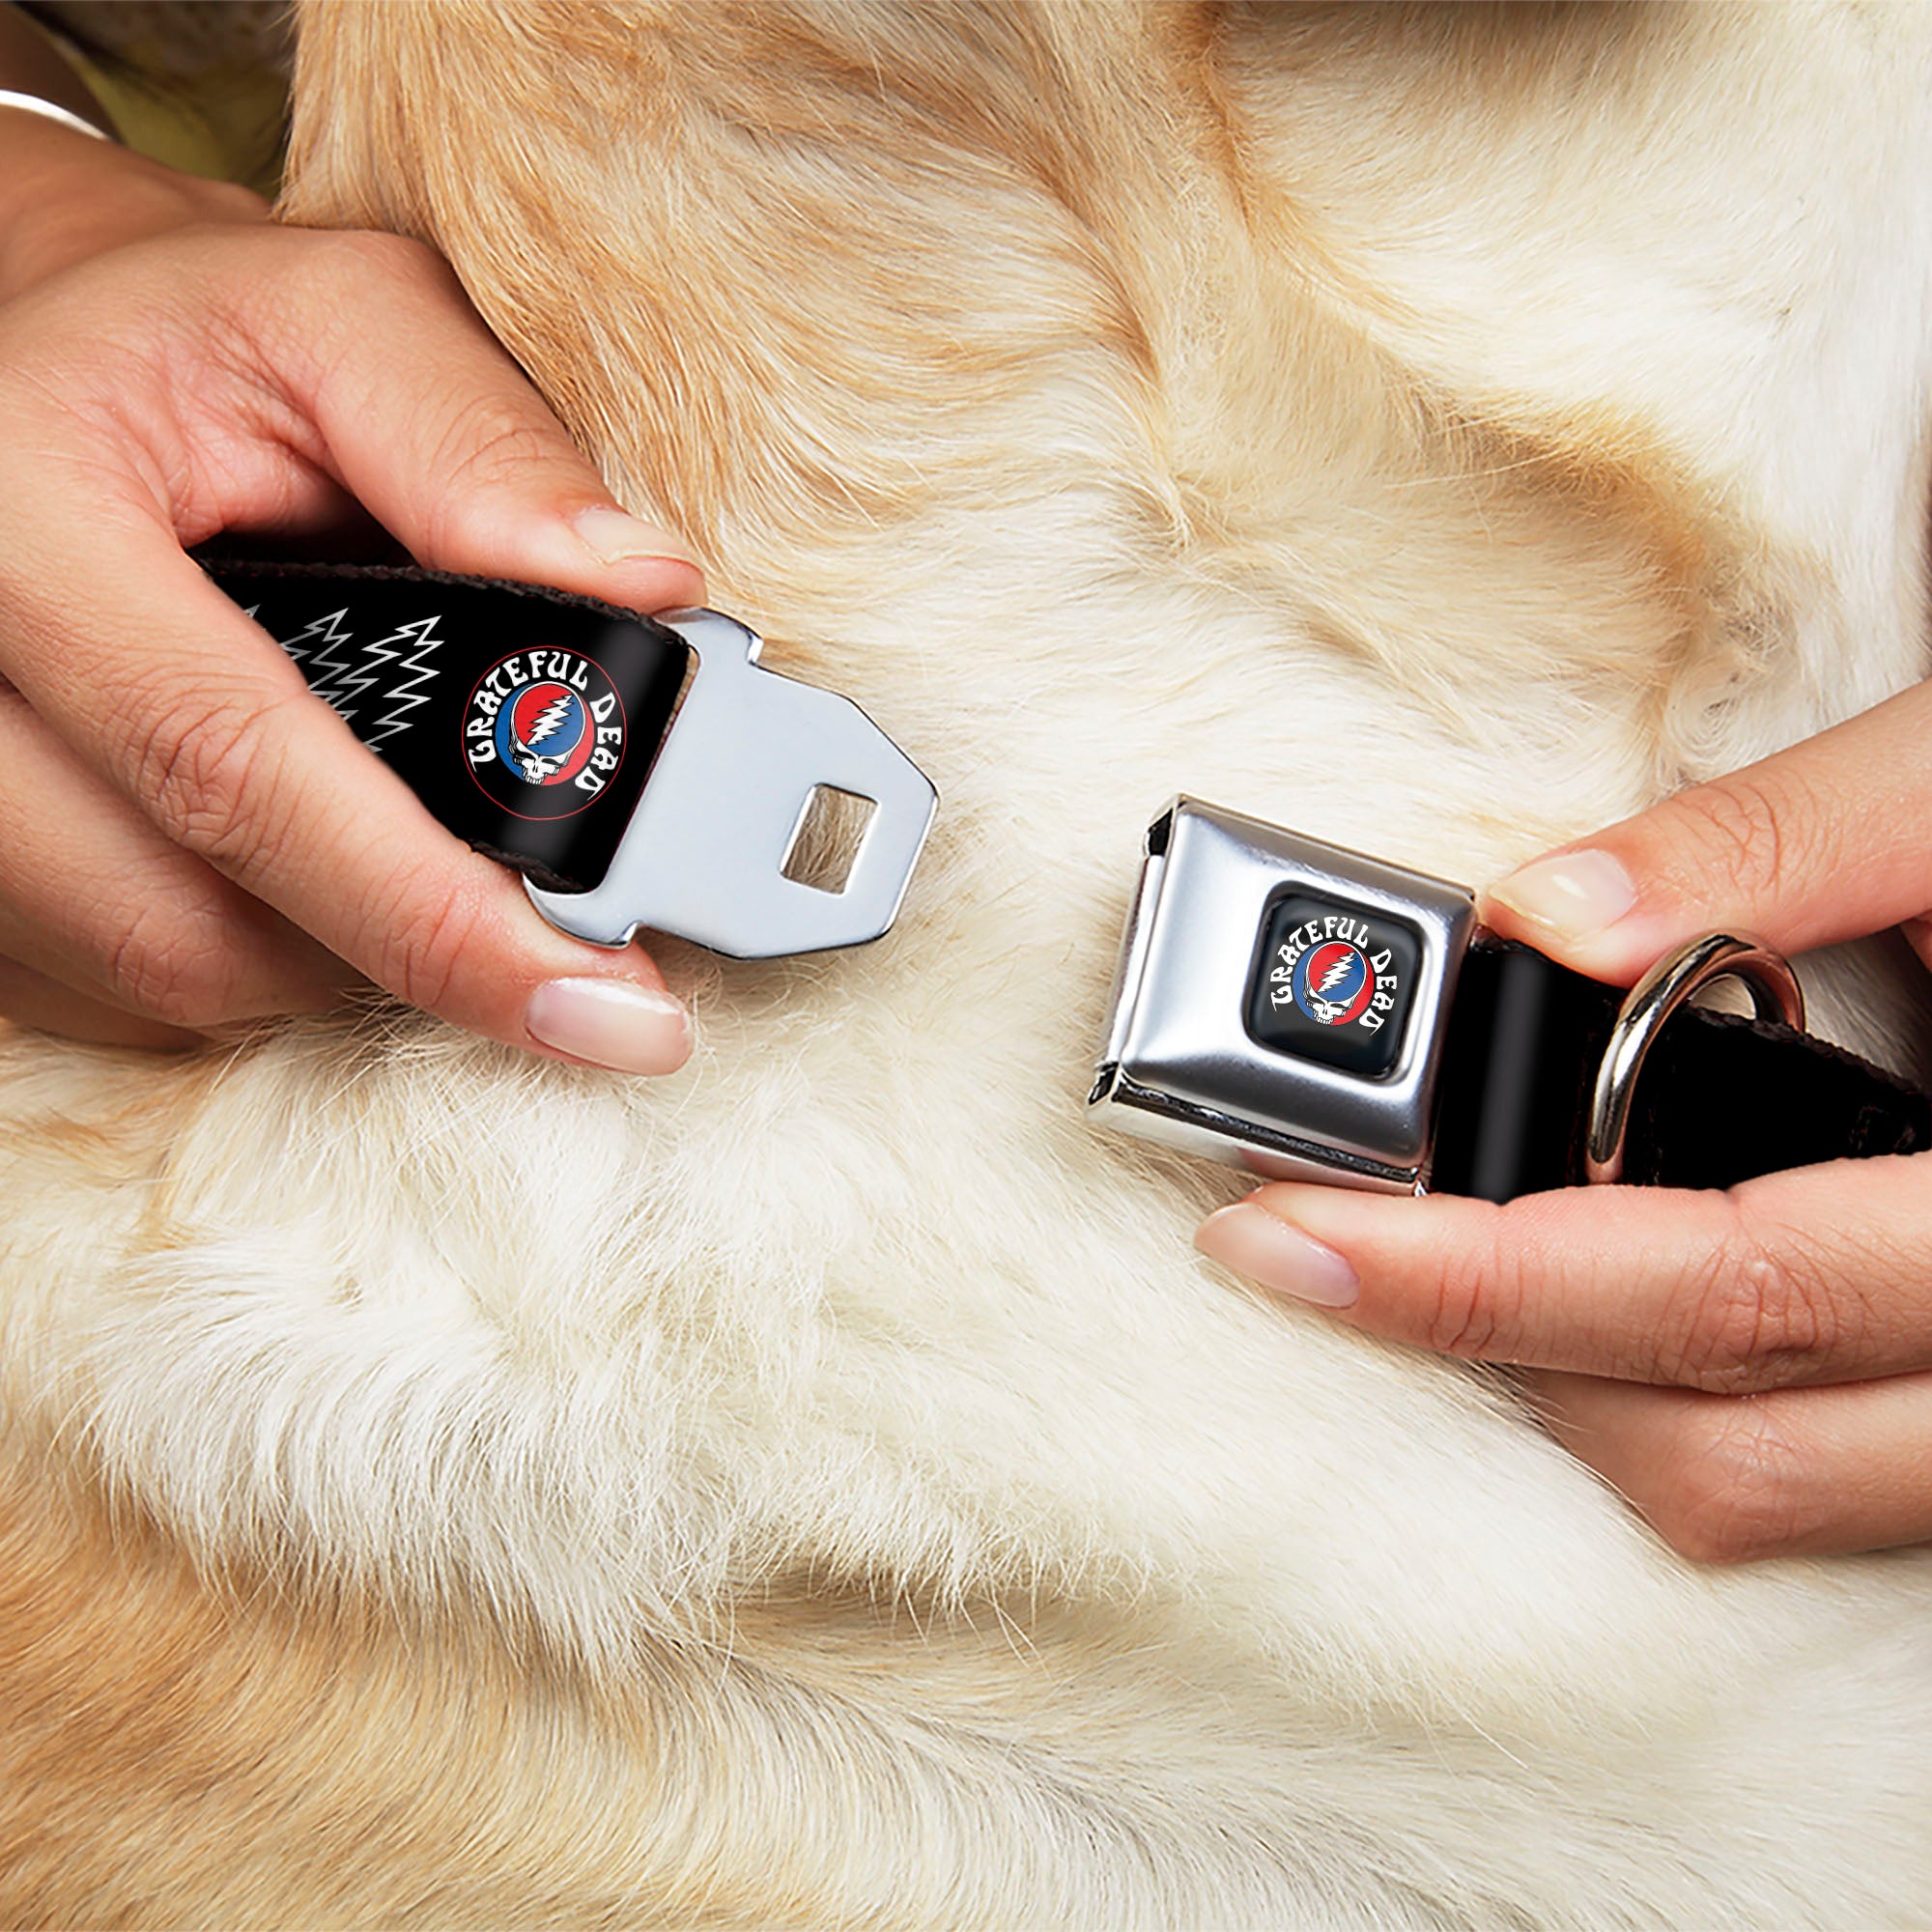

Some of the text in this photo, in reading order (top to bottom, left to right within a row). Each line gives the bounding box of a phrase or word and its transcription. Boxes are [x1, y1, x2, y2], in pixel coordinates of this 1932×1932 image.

[467, 650, 622, 801] GRATEFUL DEAD
[1270, 916, 1398, 1037] GRATEFUL DEAD
